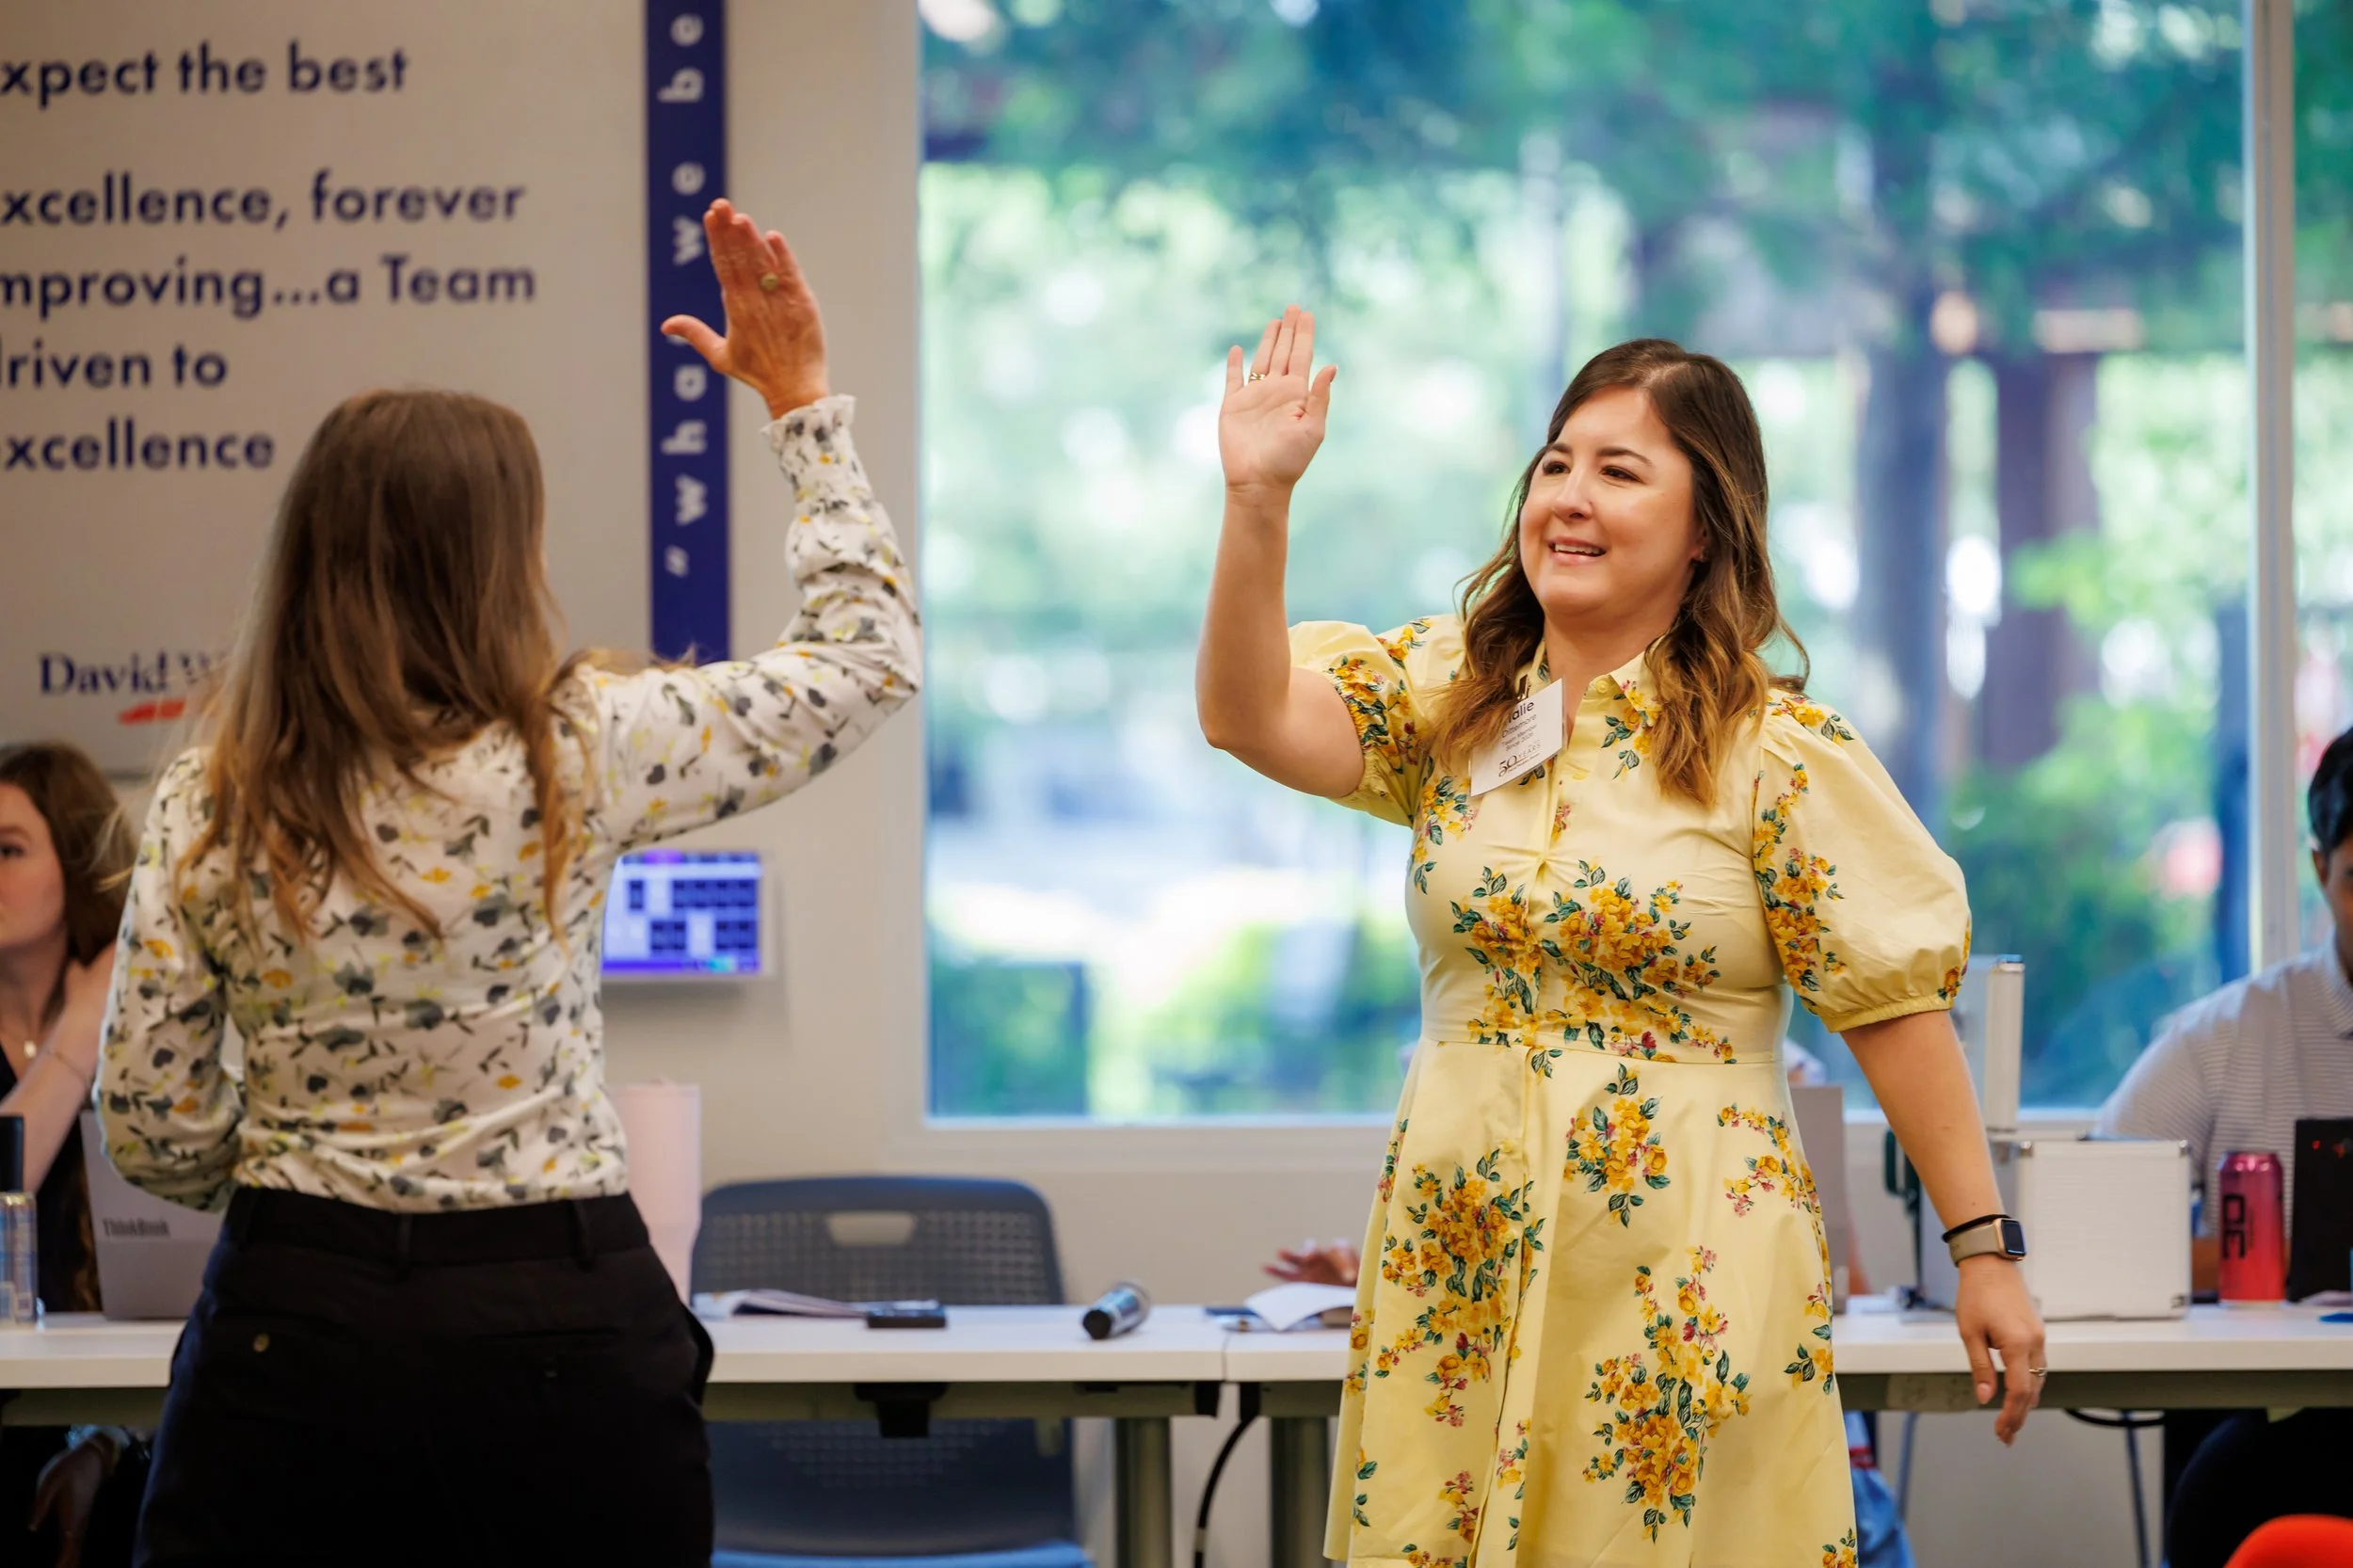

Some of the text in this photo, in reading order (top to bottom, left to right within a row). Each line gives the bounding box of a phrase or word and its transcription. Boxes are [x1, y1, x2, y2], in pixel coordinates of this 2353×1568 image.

[177, 40, 267, 94] the
[287, 40, 408, 94] best
[310, 168, 525, 223] forever
[672, 162, 705, 265] we
[380, 254, 536, 305] Team
[0, 337, 229, 390] riven to
[4, 416, 275, 472] xcellence
[40, 651, 168, 695] David
